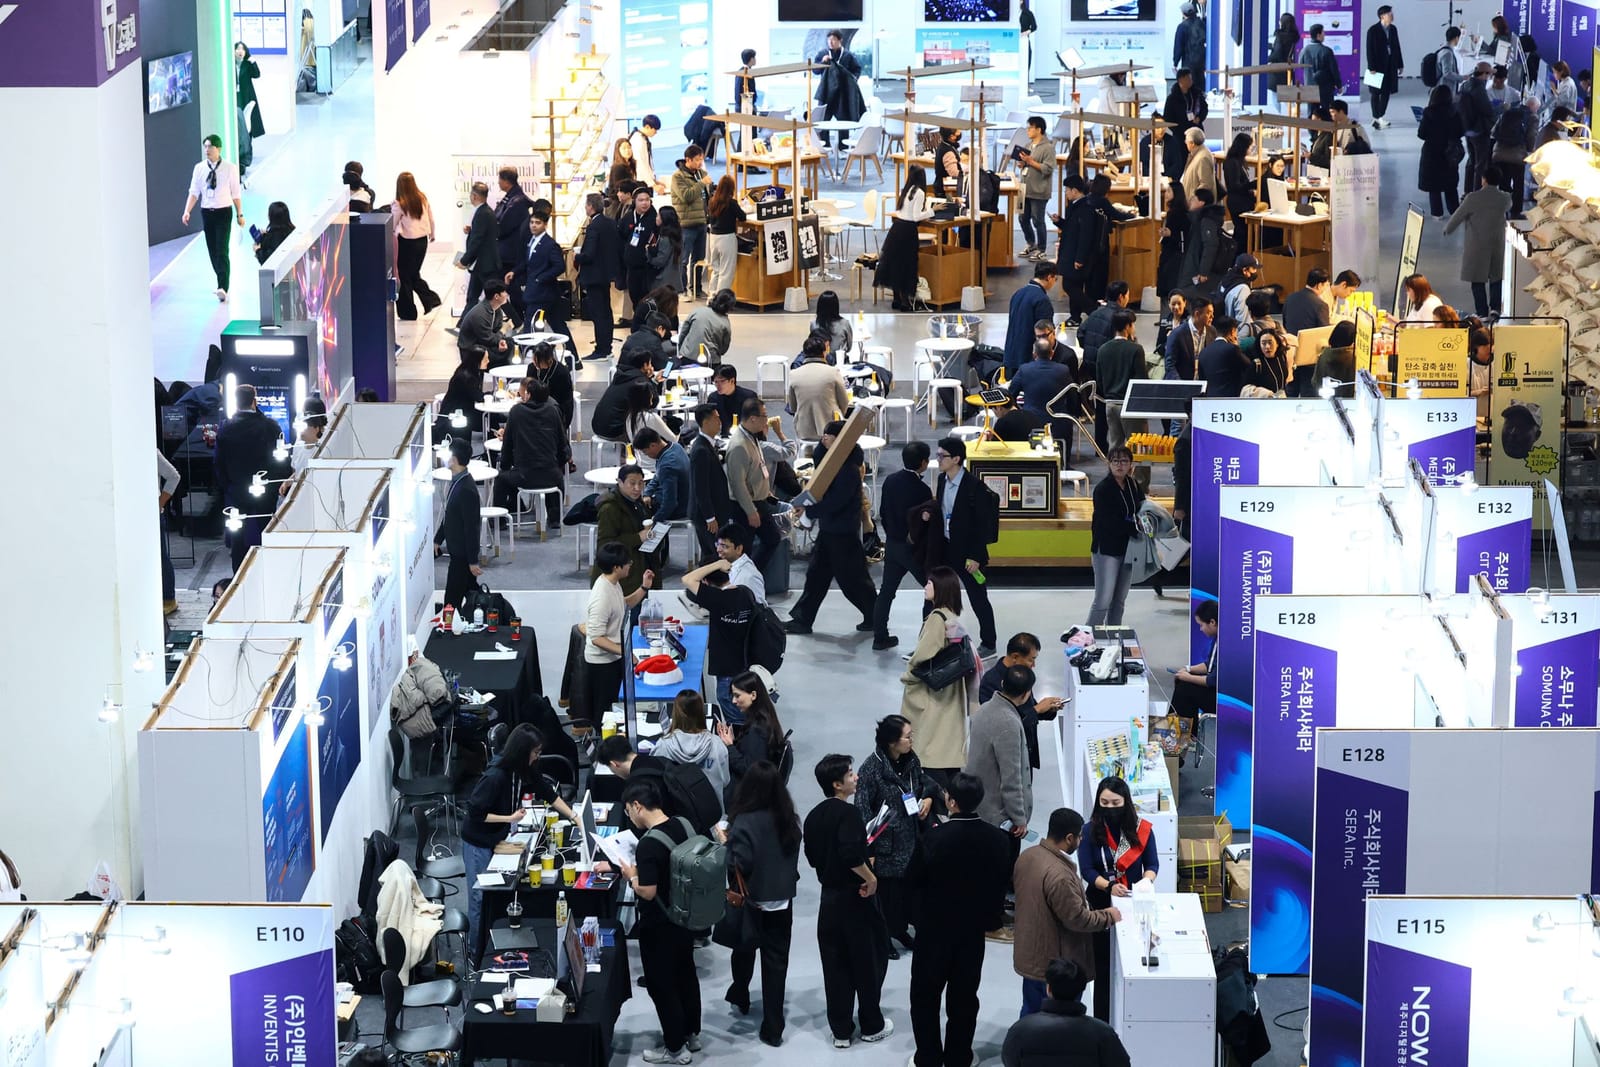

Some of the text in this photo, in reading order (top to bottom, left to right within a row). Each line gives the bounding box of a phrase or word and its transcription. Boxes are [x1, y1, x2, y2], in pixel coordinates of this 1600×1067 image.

[1405, 362, 1420, 371] 탄소
[1422, 362, 1437, 371] 감축
[1211, 412, 1243, 423] E130
[1427, 412, 1458, 423] E133
[1227, 457, 1240, 483] 바크
[1240, 501, 1275, 513] E129
[1478, 503, 1512, 514] E132
[1480, 551, 1490, 569] CIT
[1241, 550, 1253, 640] WILLIAMXYLITOL
[1278, 613, 1316, 625] E128
[1279, 666, 1292, 721] SERA Inc.
[1540, 665, 1553, 718] SOMUNA
[1558, 665, 1575, 709] 소무나
[1296, 666, 1314, 752] 주식회사세라
[1342, 748, 1385, 762] E128
[1343, 808, 1358, 870] SERA Inc.
[257, 927, 305, 942] E110
[1397, 919, 1446, 934] E115
[263, 994, 279, 1062] INVENTIS
[1410, 986, 1431, 1066] NOW
